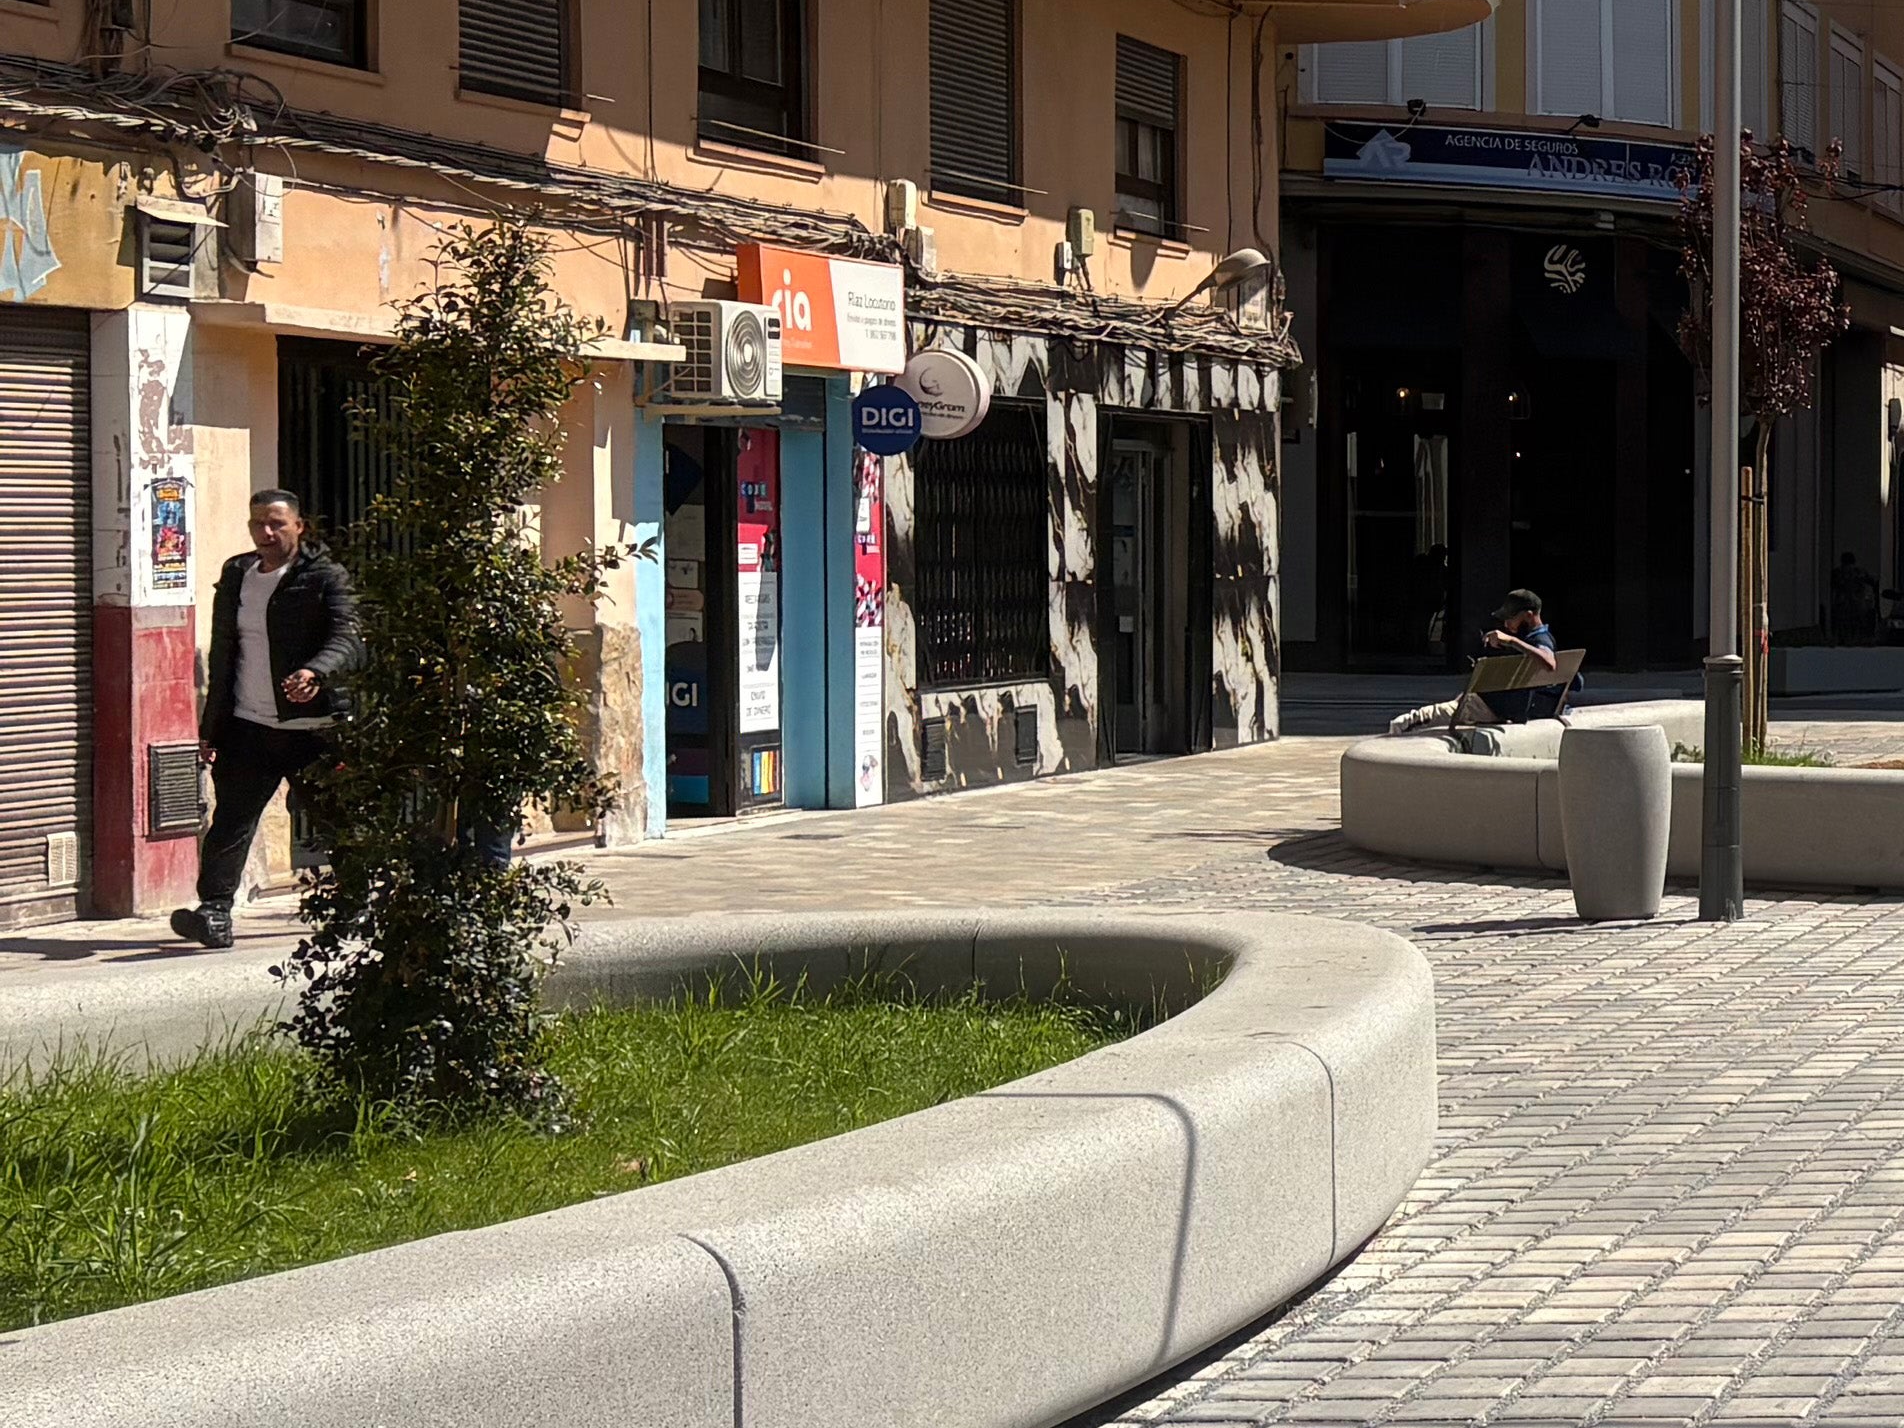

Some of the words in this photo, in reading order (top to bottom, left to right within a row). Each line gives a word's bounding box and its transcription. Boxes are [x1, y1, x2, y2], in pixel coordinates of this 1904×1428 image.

[1445, 134, 1501, 149] AGENCIA
[1505, 138, 1521, 151] DE
[1524, 139, 1579, 156] SEGUROS
[1527, 152, 1642, 185] ANDRES
[861, 406, 914, 427] DIGI
[665, 682, 698, 707] IGI
